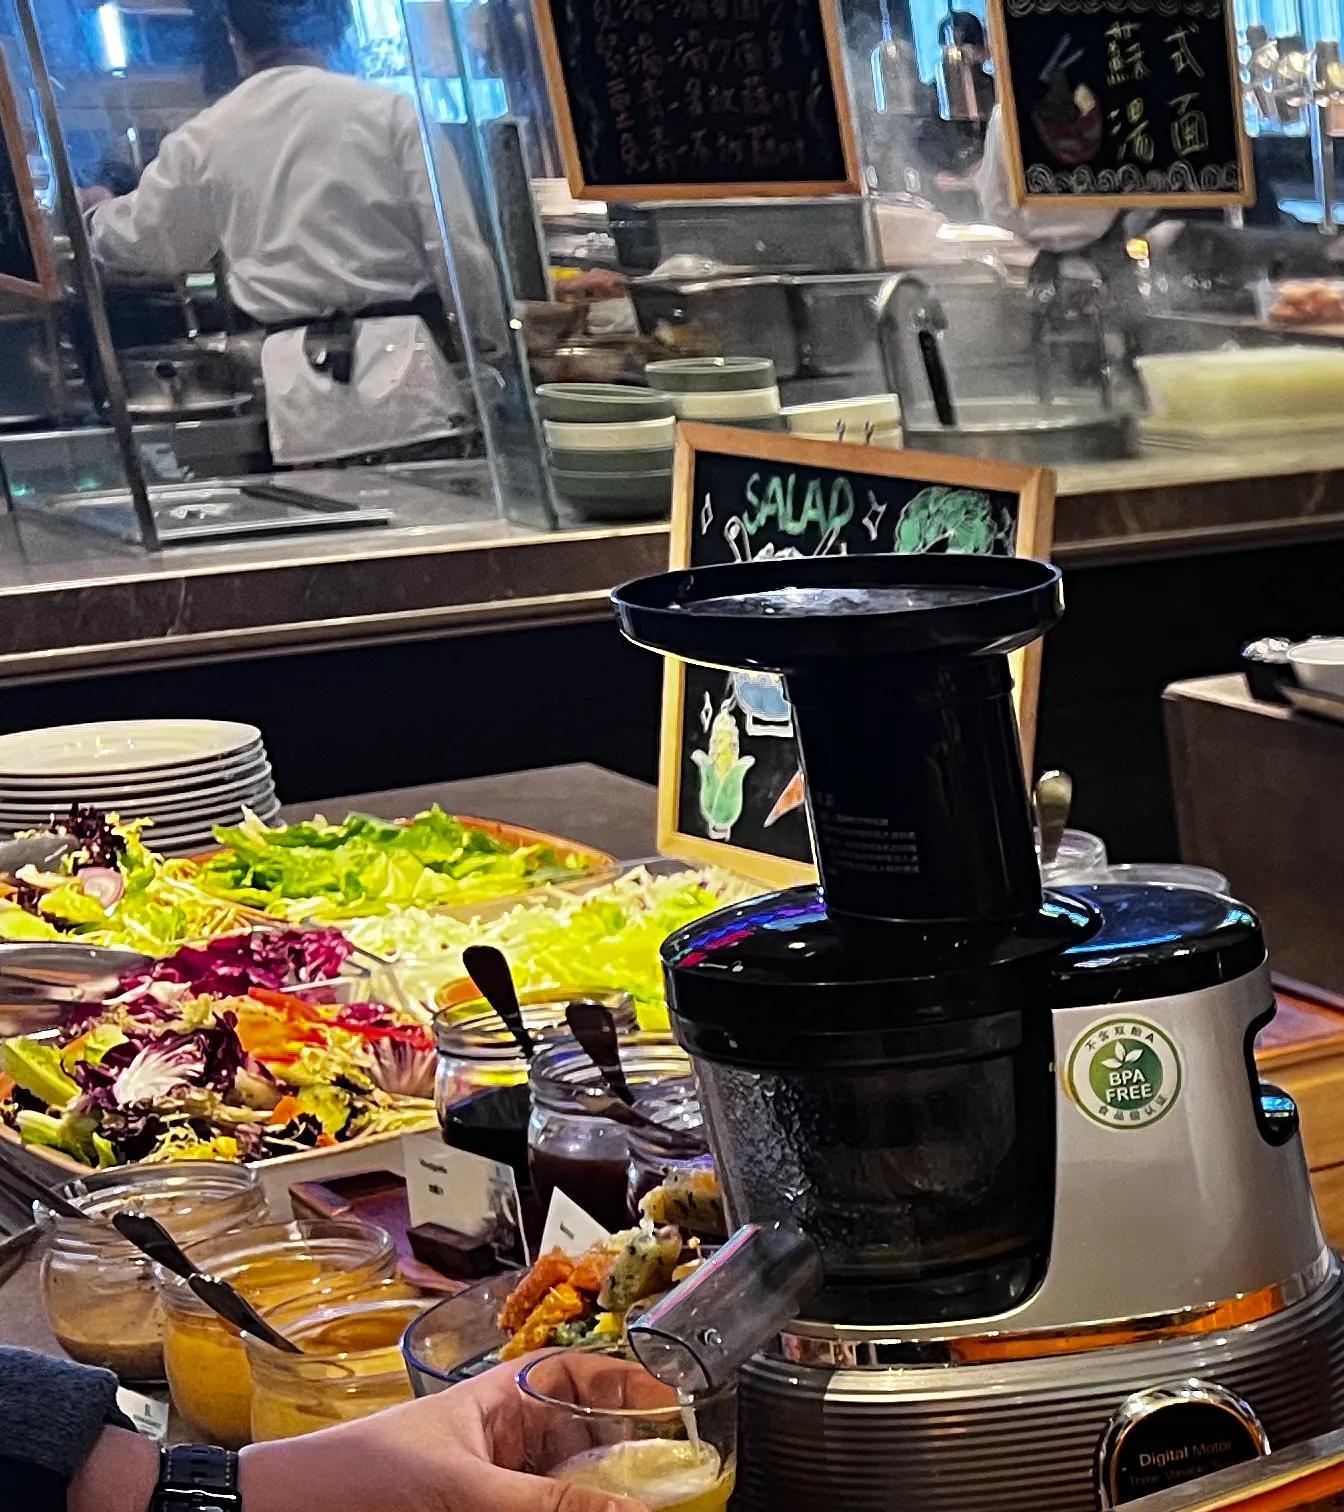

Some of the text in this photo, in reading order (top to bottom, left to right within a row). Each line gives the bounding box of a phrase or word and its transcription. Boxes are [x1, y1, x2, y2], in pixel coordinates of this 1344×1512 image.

[742, 472, 854, 536] SALAD
[1108, 1068, 1145, 1087] BPA
[1106, 1082, 1153, 1103] FREE
[1138, 1440, 1233, 1468] Digital Motor
